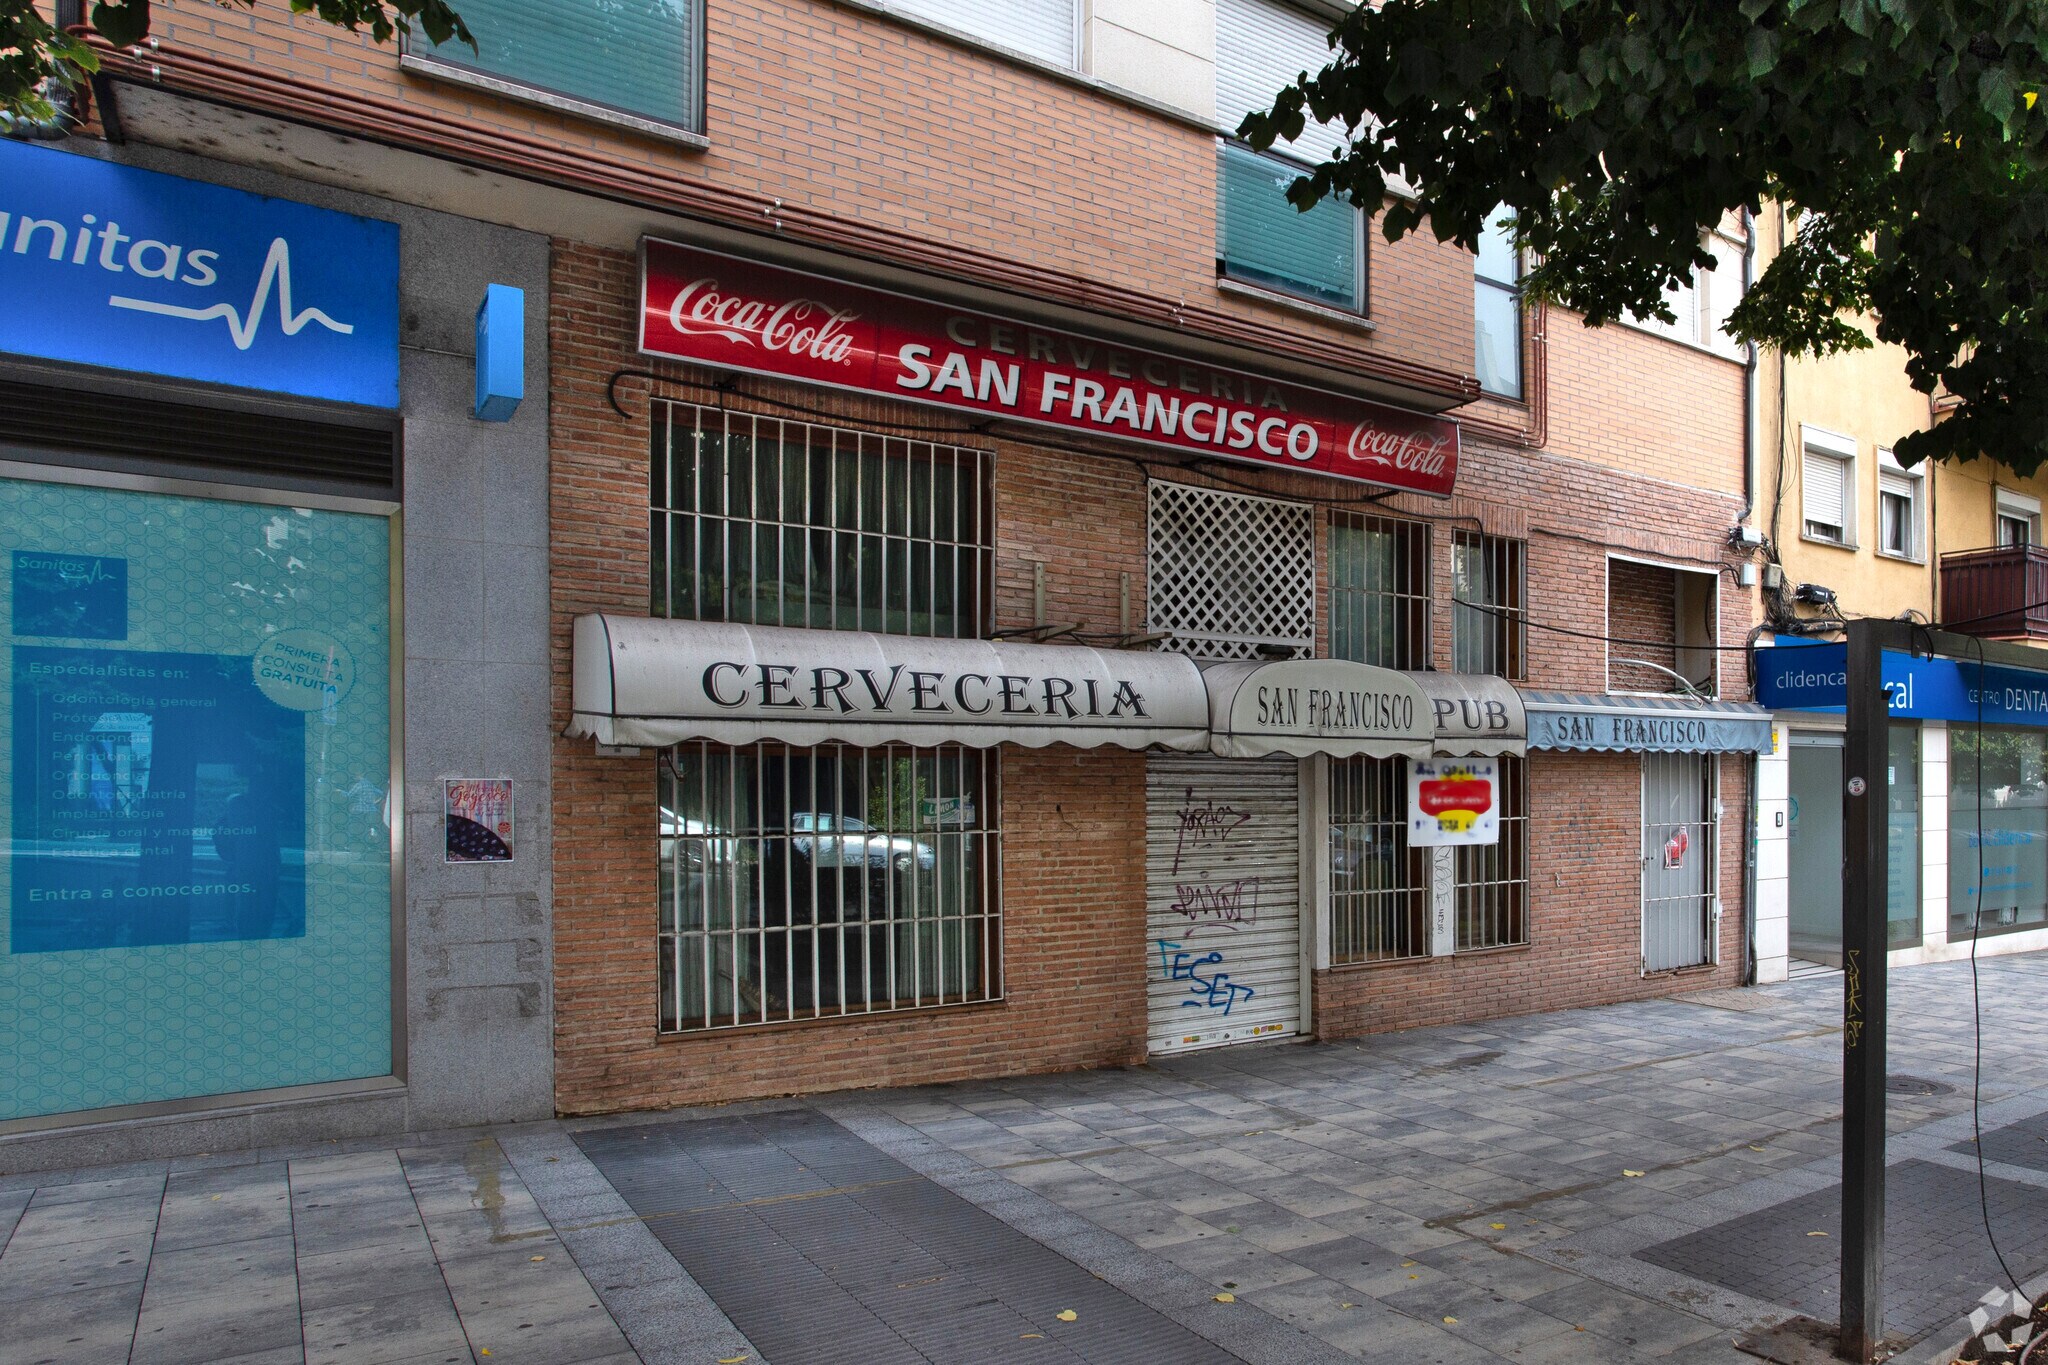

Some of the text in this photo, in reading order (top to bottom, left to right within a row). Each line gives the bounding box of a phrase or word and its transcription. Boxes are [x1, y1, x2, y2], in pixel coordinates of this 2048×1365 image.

[0, 211, 220, 287] nitas
[669, 278, 862, 364] Coca-Cola
[946, 316, 1288, 413] CERVECERIA
[896, 343, 1319, 461] SAN FRANCISCO
[1347, 419, 1451, 477] Coca-Cola
[18, 556, 86, 573] Sanitas
[29, 662, 190, 679] Especialistas en:
[261, 668, 337, 693] GRATUITA
[160, 696, 217, 707] general
[702, 662, 1153, 720] CERVECERIA
[1257, 685, 1413, 731] SAN FRANCISCO
[1432, 697, 1510, 732] PUB
[1557, 716, 1706, 744] SAN FRANCISCO
[117, 827, 147, 838] oral
[29, 882, 257, 902] Entra a conocernos.
